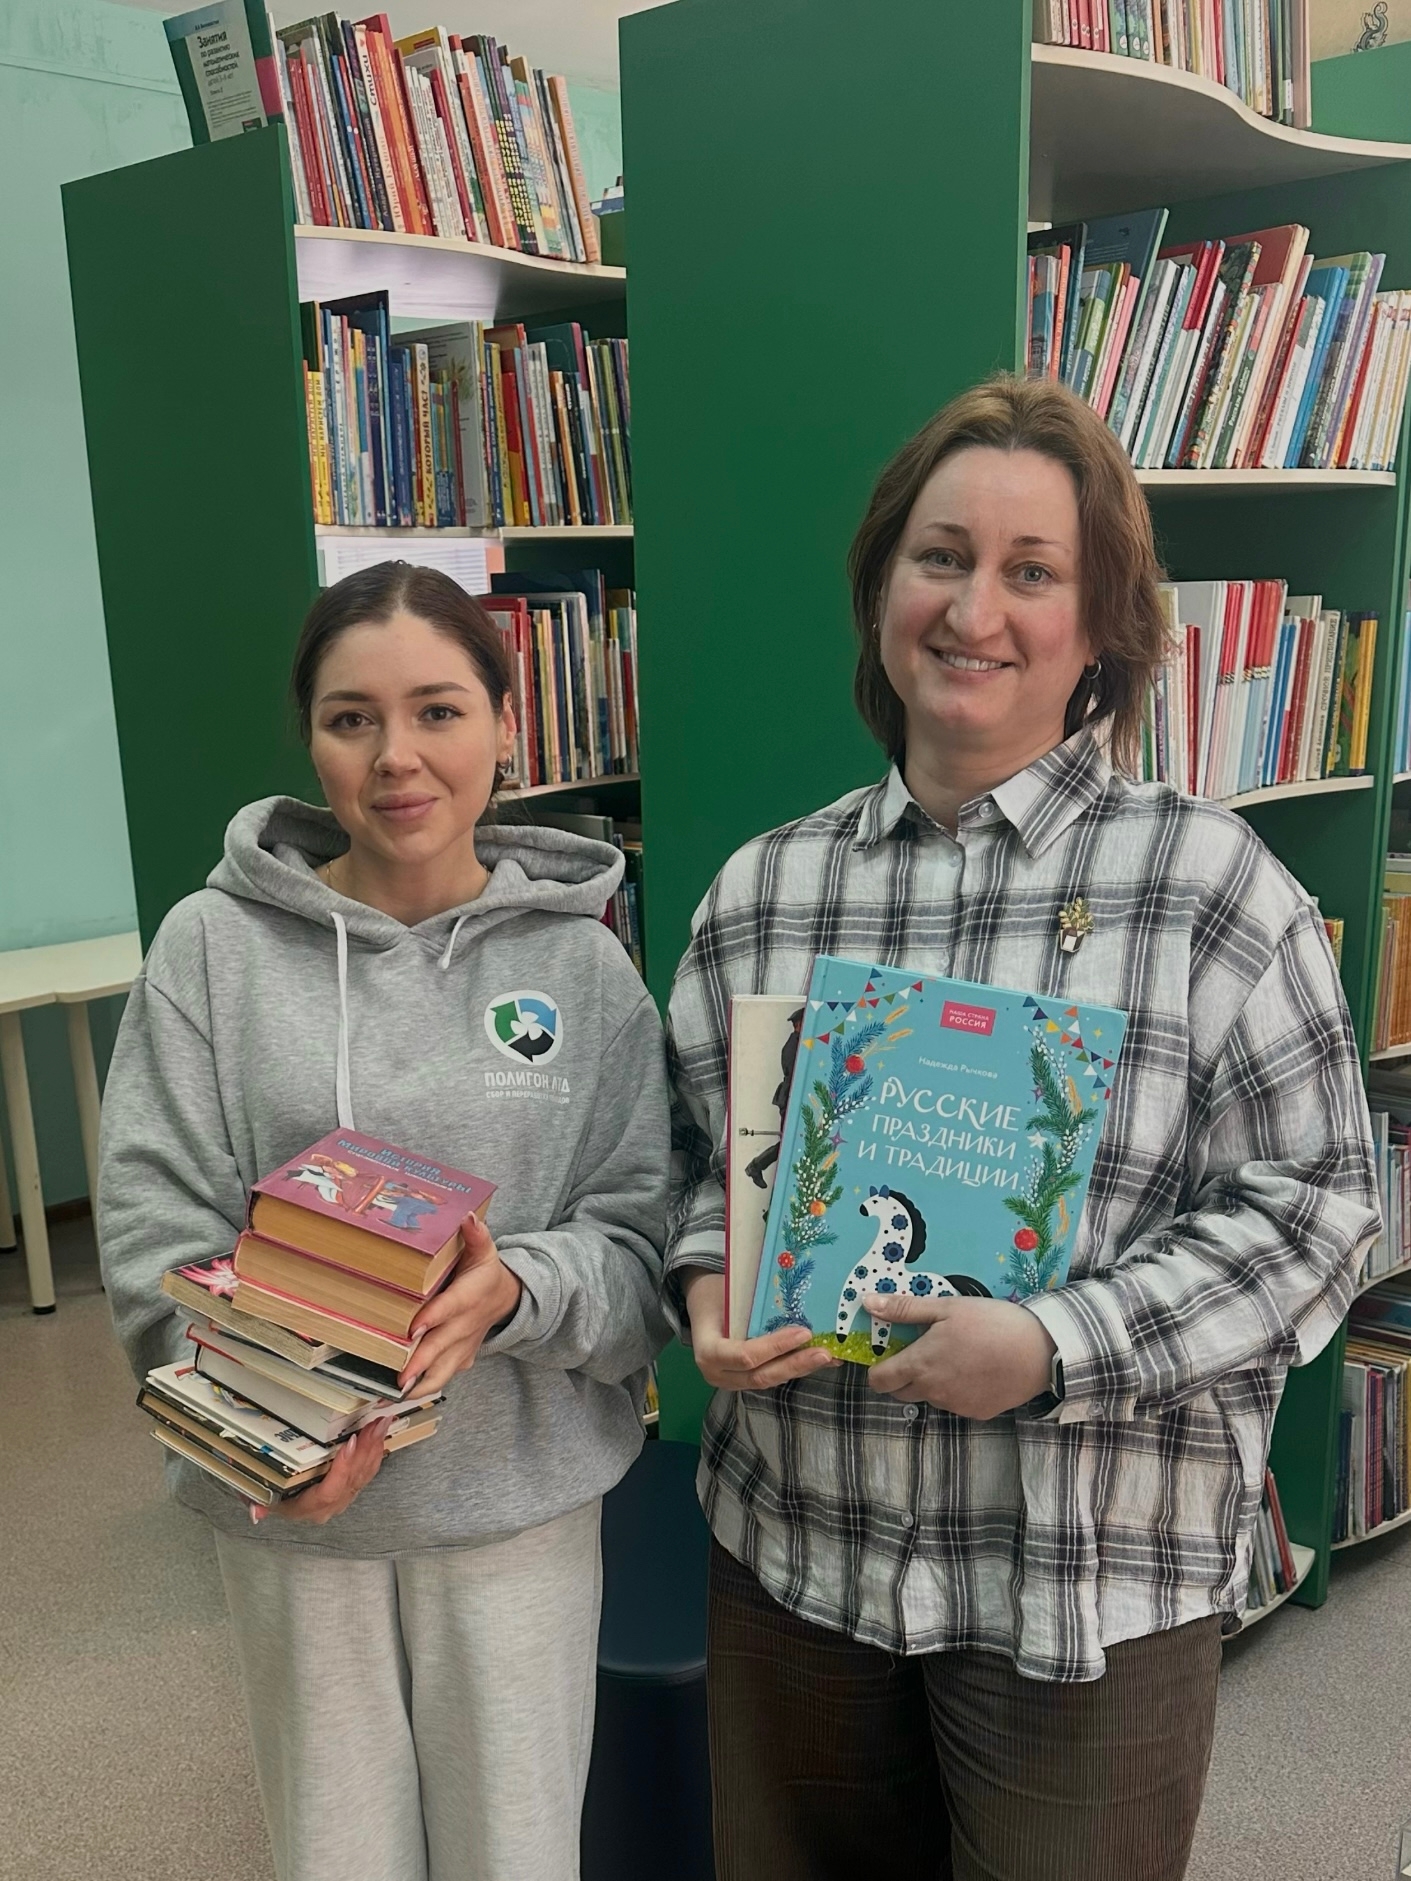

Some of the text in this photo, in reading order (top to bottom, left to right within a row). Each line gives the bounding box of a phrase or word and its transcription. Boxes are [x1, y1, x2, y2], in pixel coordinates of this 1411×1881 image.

[197, 31, 227, 49] Занятия
[362, 53, 378, 106] Стихи
[377, 183, 390, 217] Андрей
[389, 182, 401, 219] Юрий
[314, 378, 326, 457] МЫ НАРИСУЕМ ДОМ
[423, 420, 433, 475] КОТОРЫЙ
[949, 1009, 989, 1021] НАША СТРАНА
[949, 1016, 987, 1029] РОССИЯ
[484, 1071, 549, 1089] ПОЛИГОН
[919, 1056, 998, 1079] Надежда Рычкова
[486, 1090, 504, 1098] СБОР
[505, 1090, 511, 1098] И
[880, 1076, 1021, 1131] РУССКИЕ
[872, 1114, 1017, 1160] ПРАЗДНИКИ
[858, 1140, 1019, 1190] И ТРАДИЦИИ
